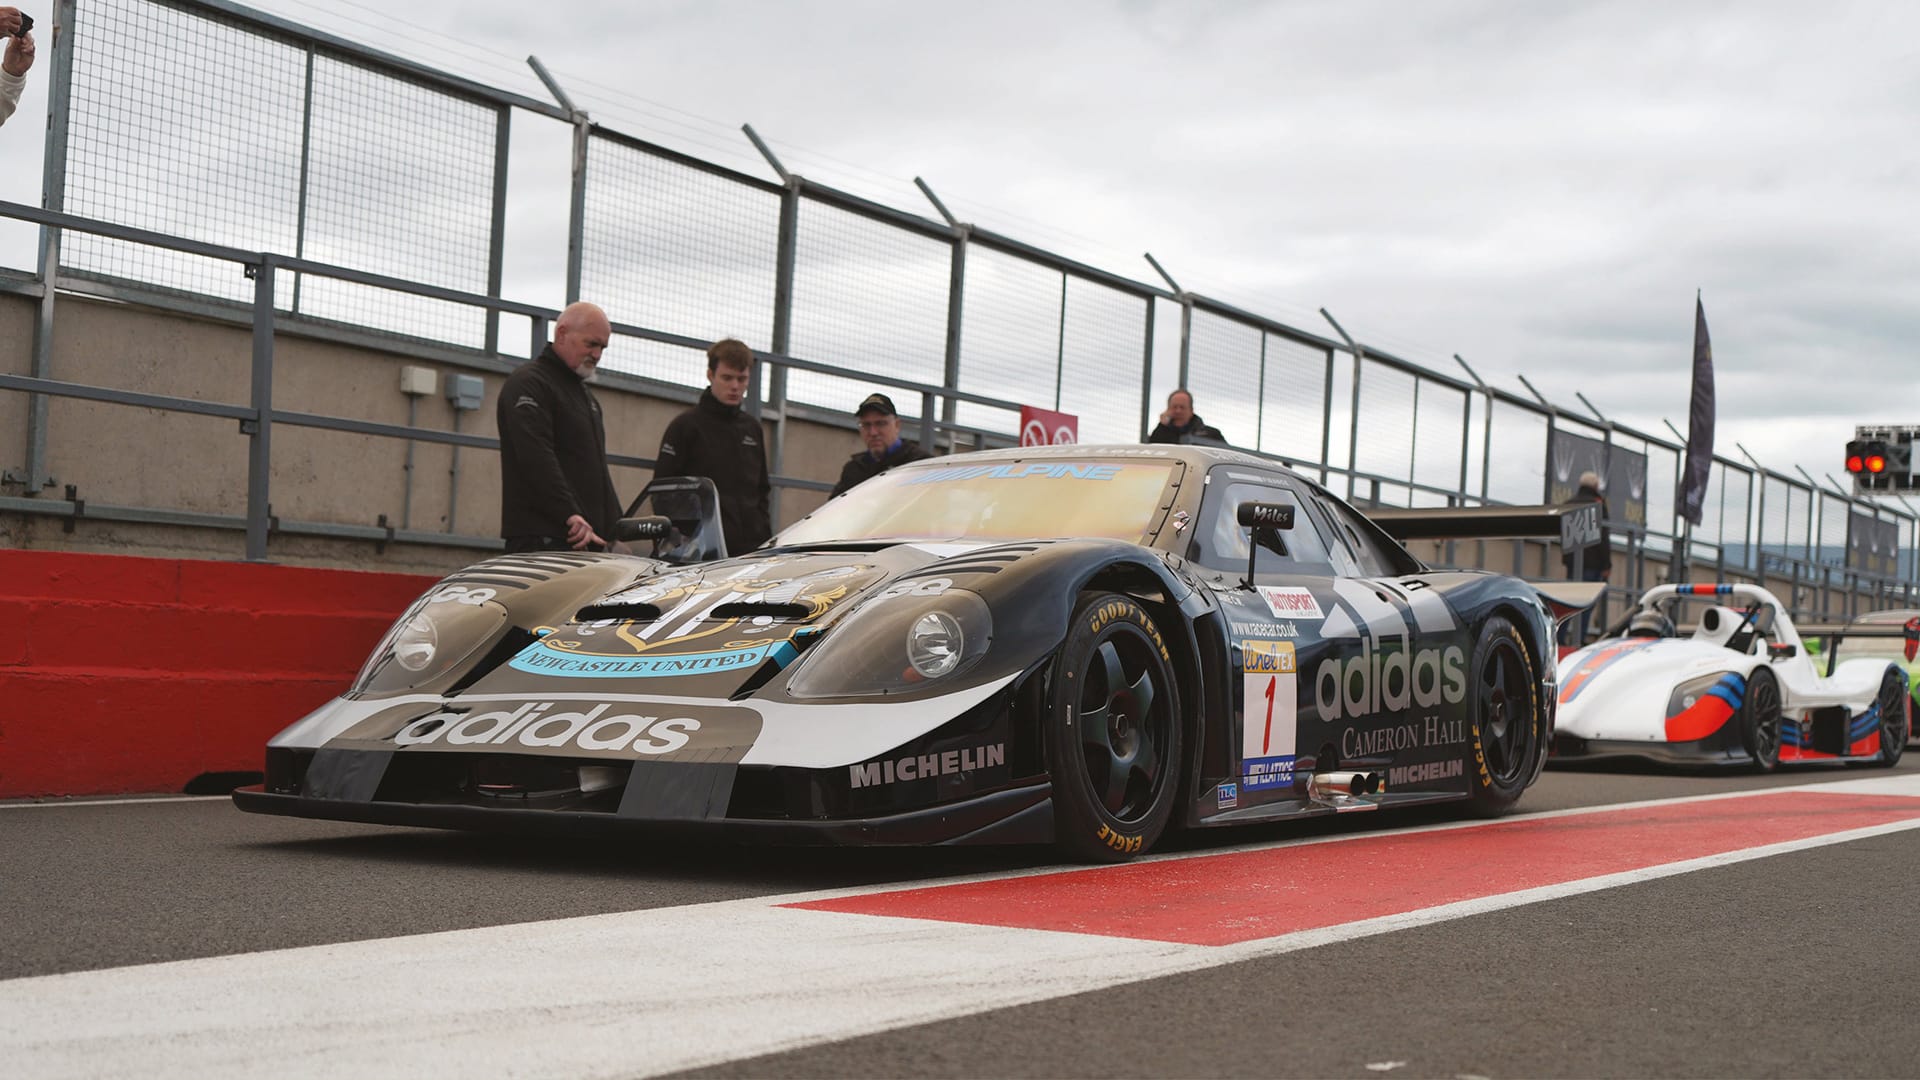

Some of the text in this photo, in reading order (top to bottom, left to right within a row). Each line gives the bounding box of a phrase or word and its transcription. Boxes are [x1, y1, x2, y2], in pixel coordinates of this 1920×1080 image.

[962, 463, 1122, 481] ALPINE
[1253, 505, 1288, 522] Miles
[1561, 507, 1600, 551] DELL
[520, 651, 758, 673] NEWCASTLE UNITED
[1315, 635, 1466, 723] adidas
[395, 702, 701, 755] adidas
[1262, 675, 1277, 756] 1
[1342, 716, 1466, 759] CAMERON HALL
[849, 743, 1005, 789] MICHELIN
[1389, 759, 1463, 785] MICHELIN
[1097, 822, 1143, 853] EAGLE
